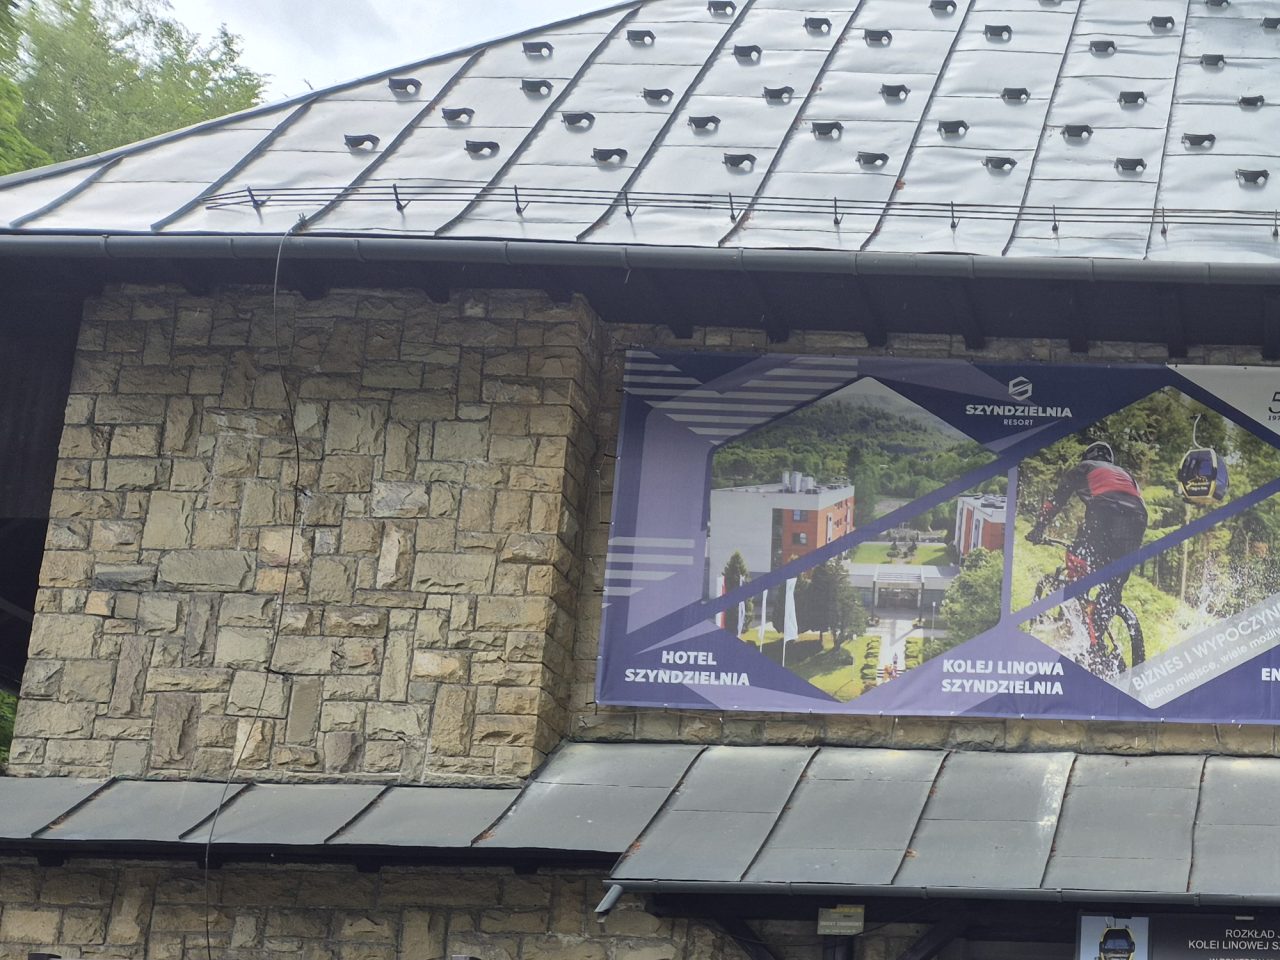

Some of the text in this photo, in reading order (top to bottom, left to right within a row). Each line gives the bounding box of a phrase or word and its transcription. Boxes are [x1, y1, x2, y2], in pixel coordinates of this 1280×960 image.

[965, 404, 1073, 418] SZYNDZIELNIA
[1003, 418, 1033, 426] RESORT
[661, 650, 717, 665] HOTEL
[1220, 644, 1248, 665] wiele
[942, 659, 1064, 676] KOLEJ LINOWA
[1132, 655, 1184, 691] BIZNES
[624, 668, 750, 686] SZYNDZIELNIA
[941, 679, 1064, 695] SZYNDZIELNIA
[1225, 929, 1275, 939] ROZKŁAD
[1188, 940, 1220, 949] KOLEI
[1222, 941, 1269, 950] LINOWEJ
